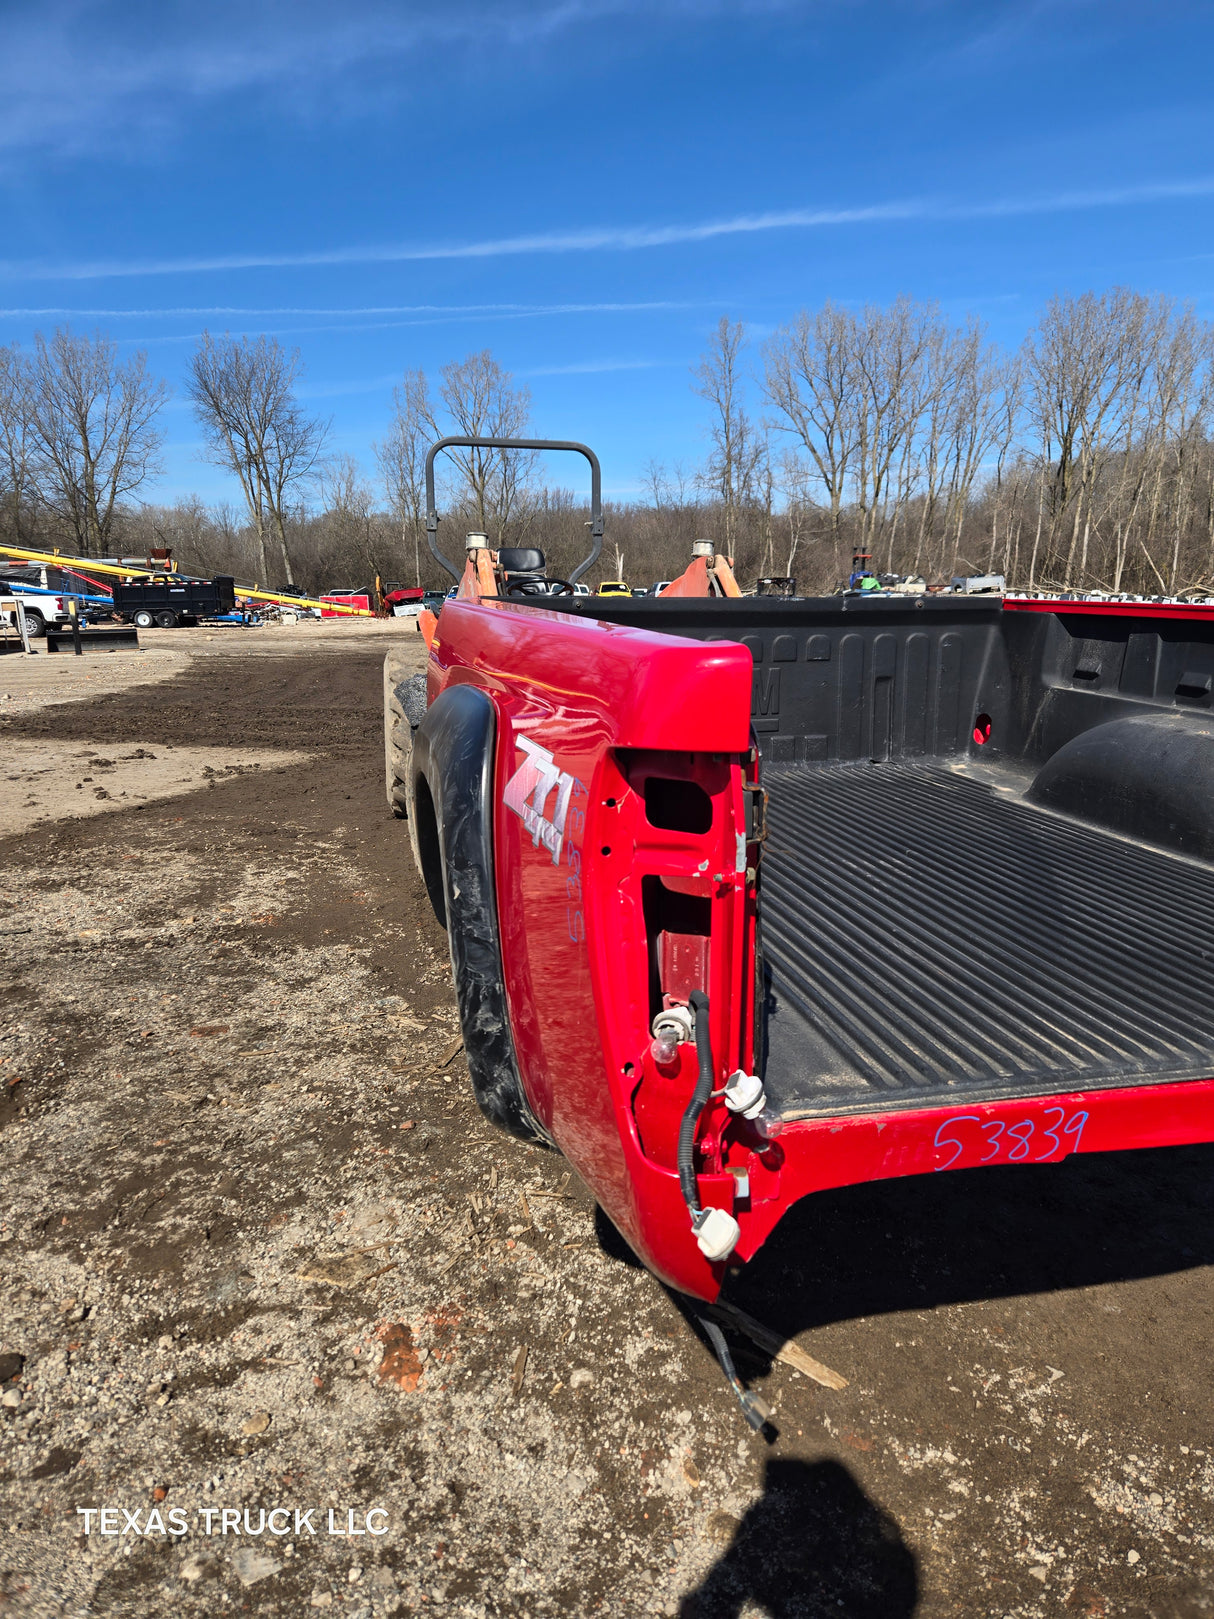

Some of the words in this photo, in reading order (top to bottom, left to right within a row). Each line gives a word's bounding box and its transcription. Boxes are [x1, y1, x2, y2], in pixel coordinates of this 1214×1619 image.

[503, 733, 574, 835] Z71
[567, 777, 589, 942] 53839
[934, 1107, 1089, 1171] 53839
